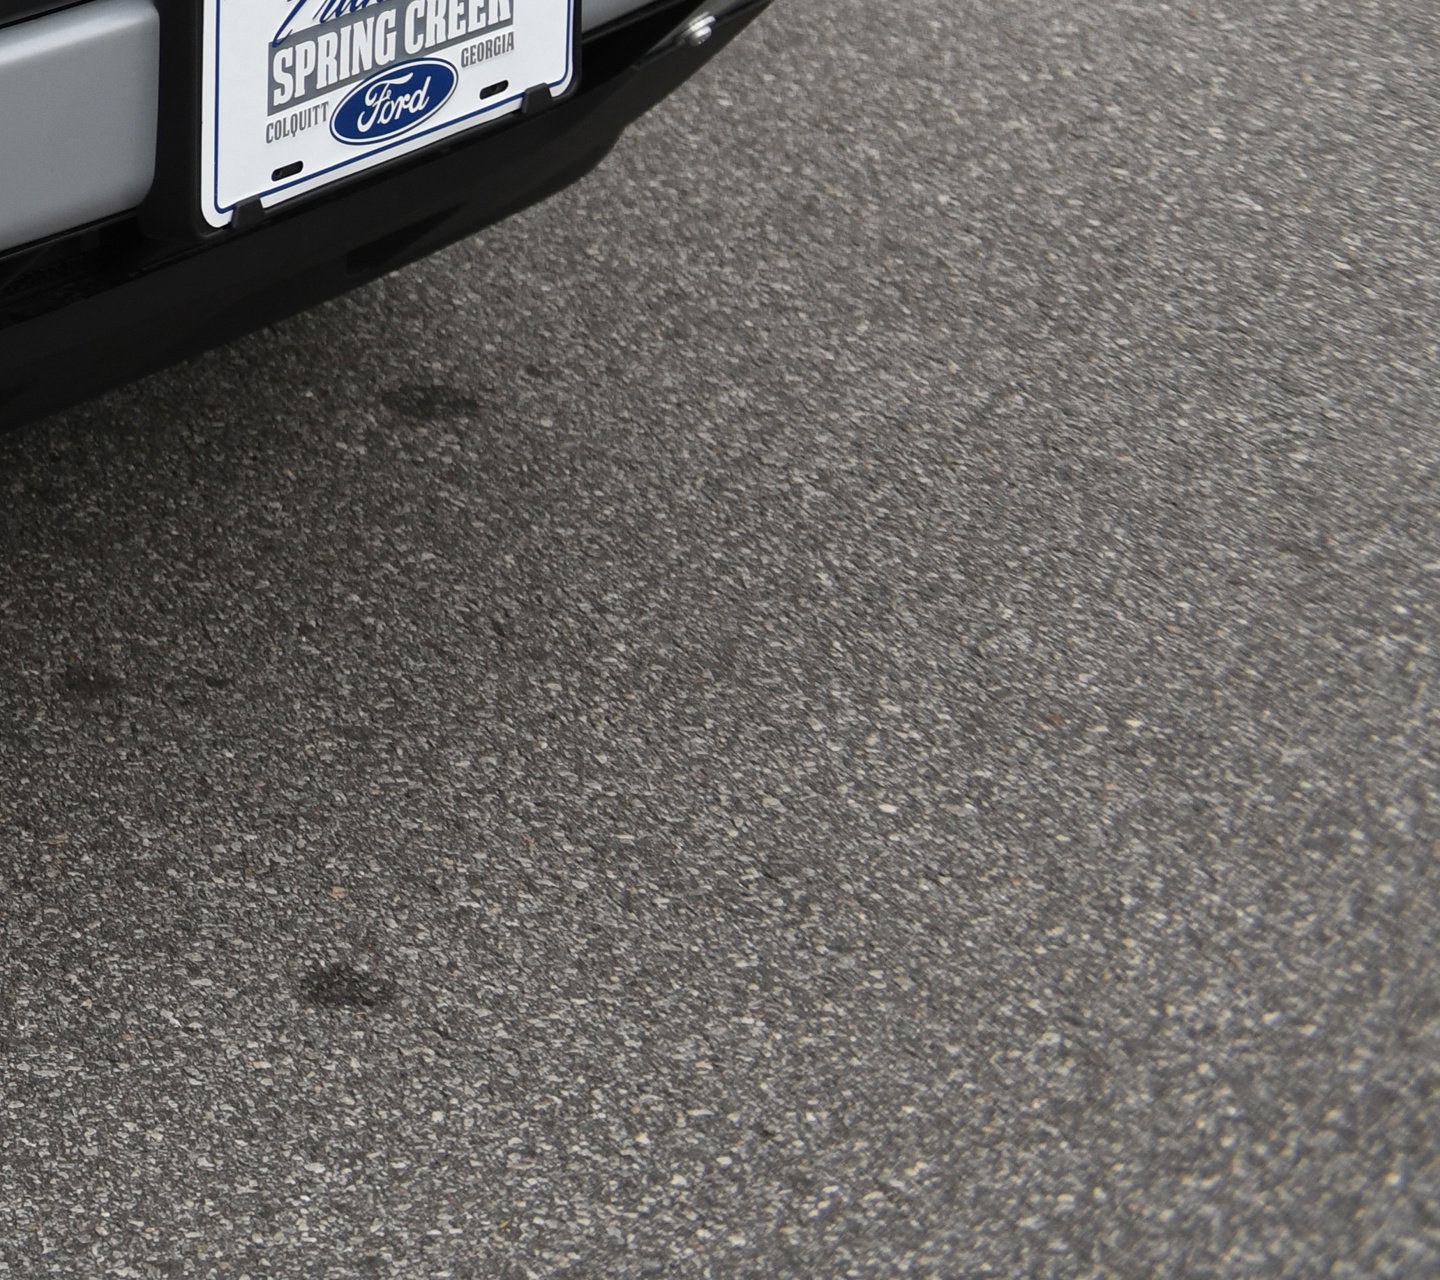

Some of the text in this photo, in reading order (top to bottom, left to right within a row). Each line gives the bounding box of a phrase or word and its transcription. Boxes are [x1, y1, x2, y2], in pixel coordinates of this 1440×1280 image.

[272, 8, 397, 107] SPRING
[460, 31, 515, 69] GEORGIA
[265, 101, 330, 144] COLQUITT
[357, 71, 433, 133] Ford
